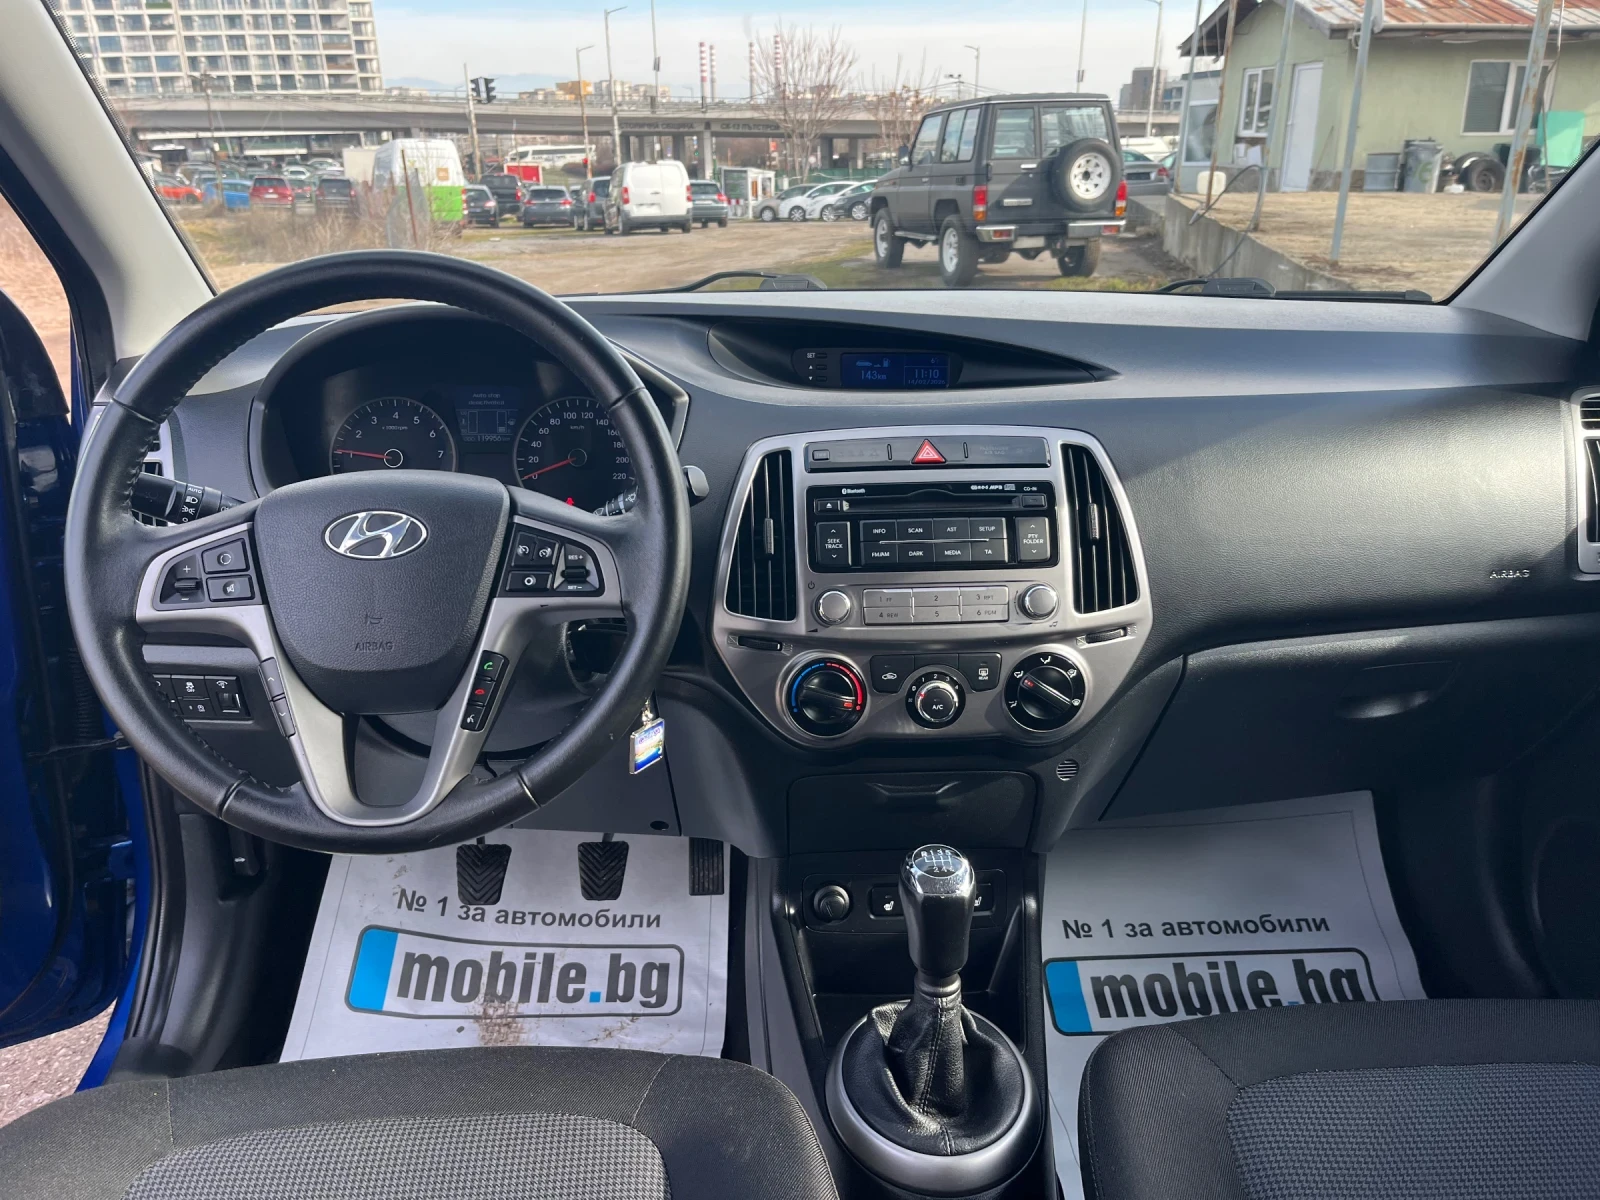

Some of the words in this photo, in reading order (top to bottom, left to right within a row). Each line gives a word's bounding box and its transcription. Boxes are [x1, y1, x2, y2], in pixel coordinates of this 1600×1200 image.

[914, 369, 940, 379] 11:10
[392, 411, 399, 420] 4
[371, 416, 378, 425] 3
[413, 416, 420, 425] 5
[355, 430, 362, 438] 2
[429, 430, 436, 438] 6
[354, 641, 394, 651] AIRBAG
[436, 895, 448, 917] 1
[457, 903, 486, 924] за
[494, 908, 661, 929] автомобили
[1101, 919, 1114, 938] 1
[1124, 919, 1152, 939] за
[1161, 914, 1331, 936] автомобили
[397, 951, 670, 1009] mobile.bg
